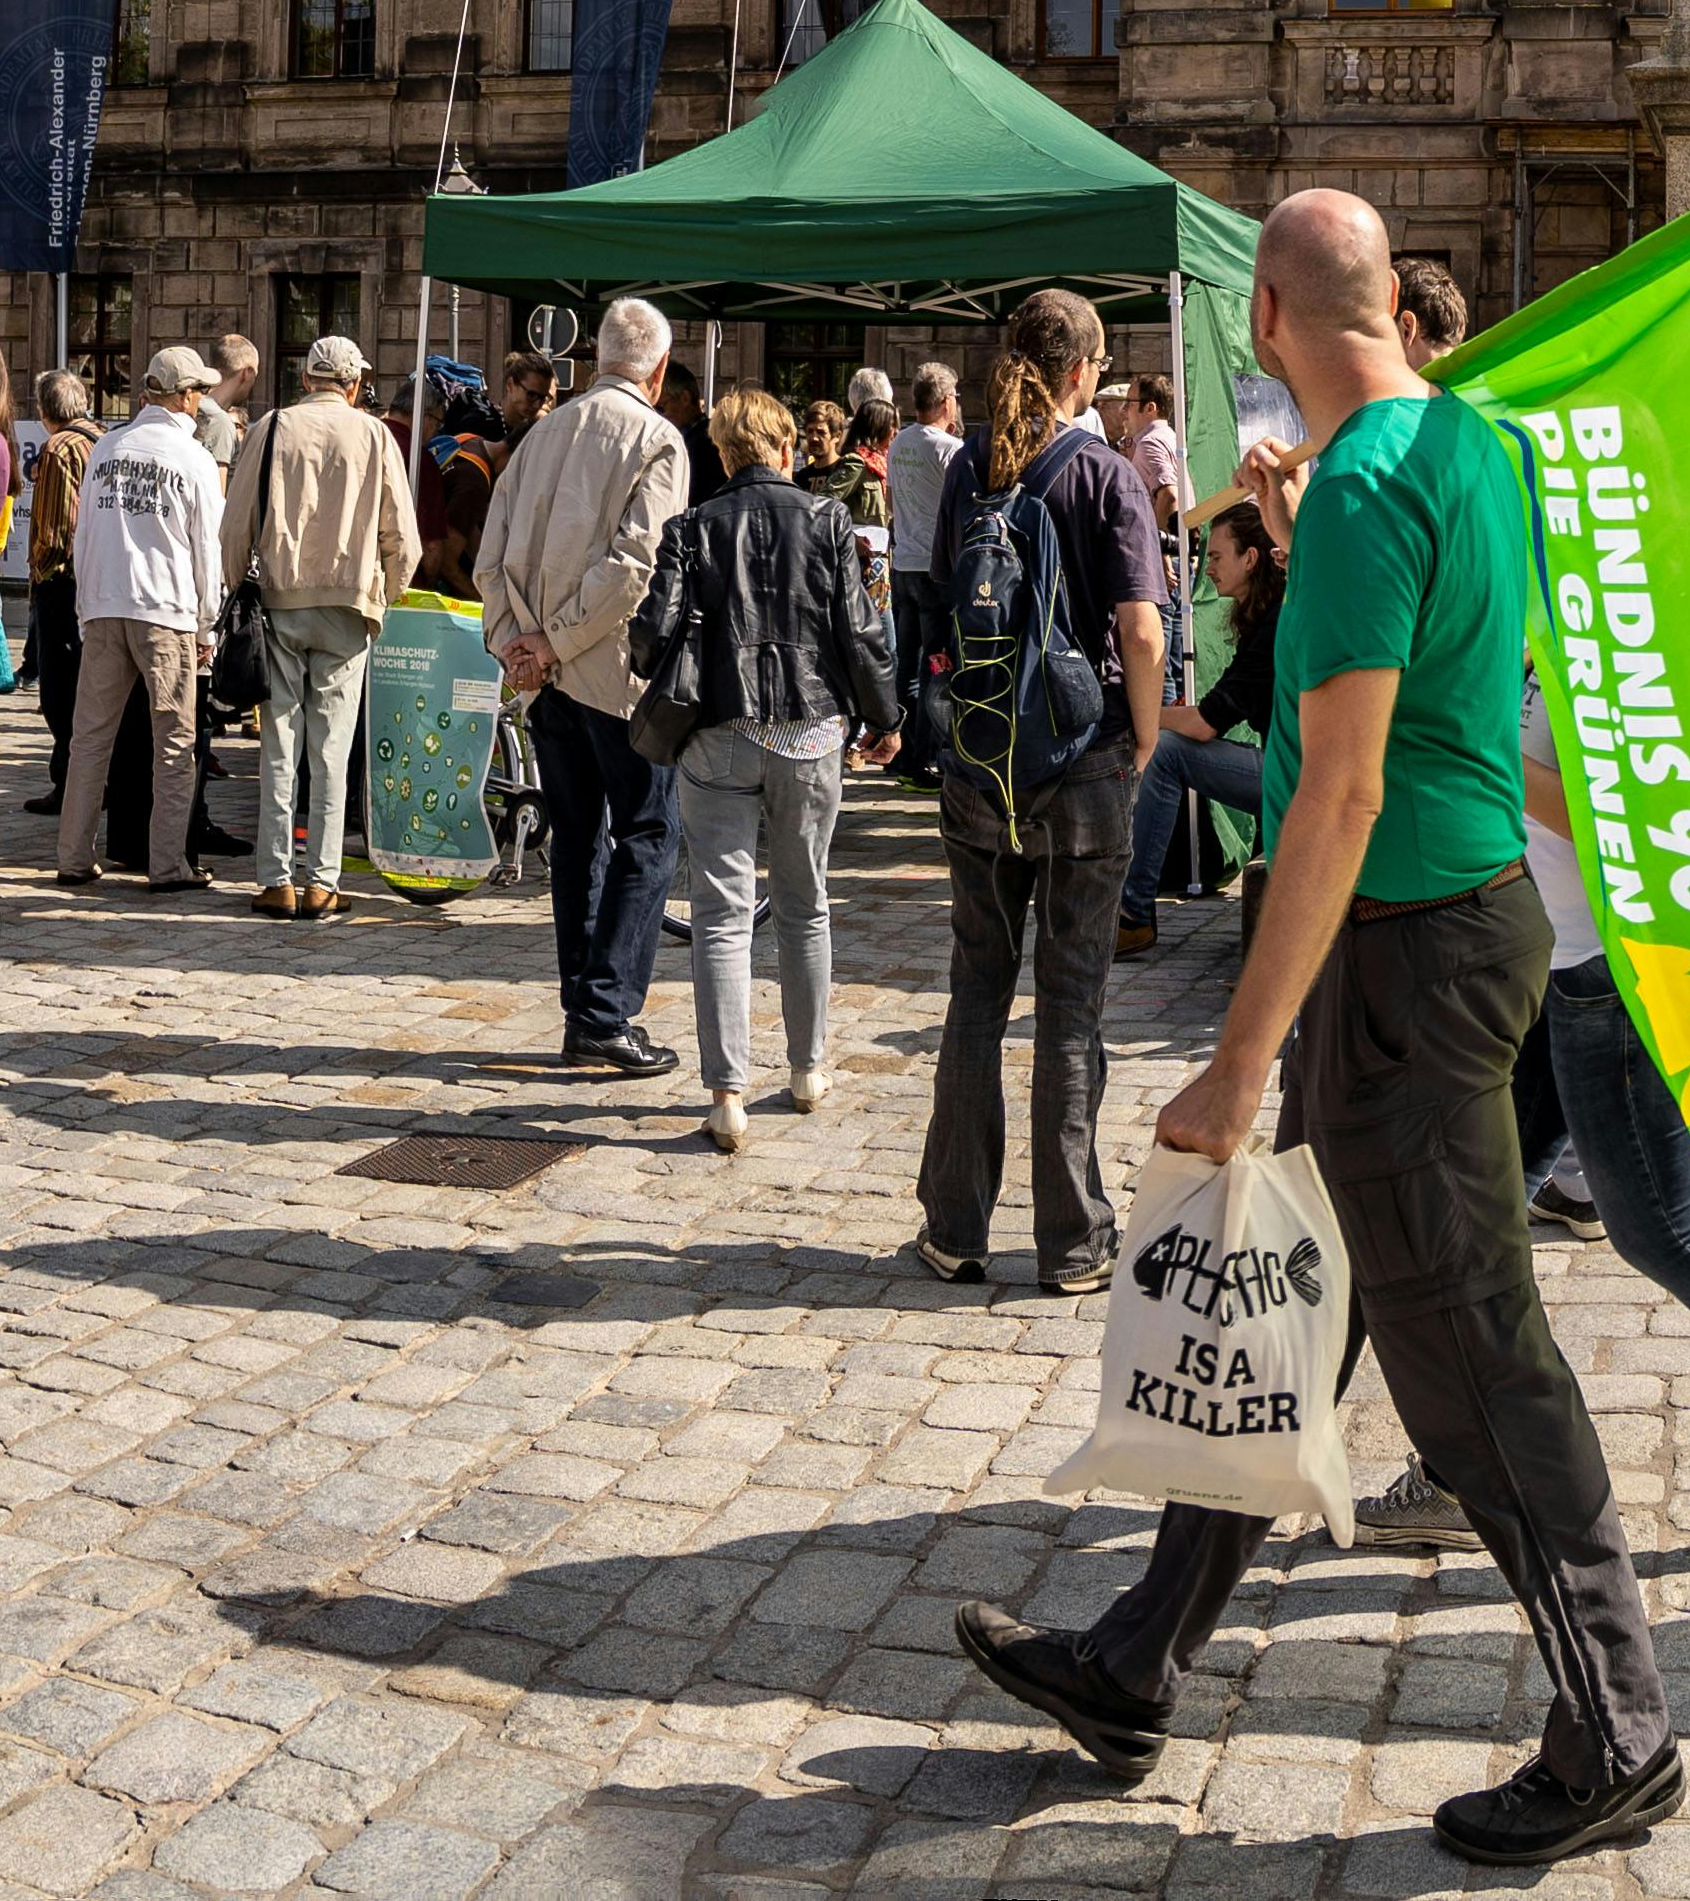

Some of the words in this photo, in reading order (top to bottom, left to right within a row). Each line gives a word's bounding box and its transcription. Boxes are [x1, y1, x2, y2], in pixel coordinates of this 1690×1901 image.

[48, 47, 65, 247] Friedrich-Alexander
[972, 598, 1000, 607] deuter
[373, 645, 439, 660] KLIMASCHUTZ-
[373, 657, 407, 670] WOCHE
[409, 660, 430, 672] 2018
[1520, 410, 1583, 538] DIE
[1557, 572, 1657, 924] GRÜNEN
[1167, 1233, 1288, 1329] PLASTIC
[1174, 1333, 1220, 1387] IS
[1223, 1348, 1256, 1390] A
[1125, 1368, 1301, 1437] KILLER
[1165, 1485, 1243, 1502] gruene.de
